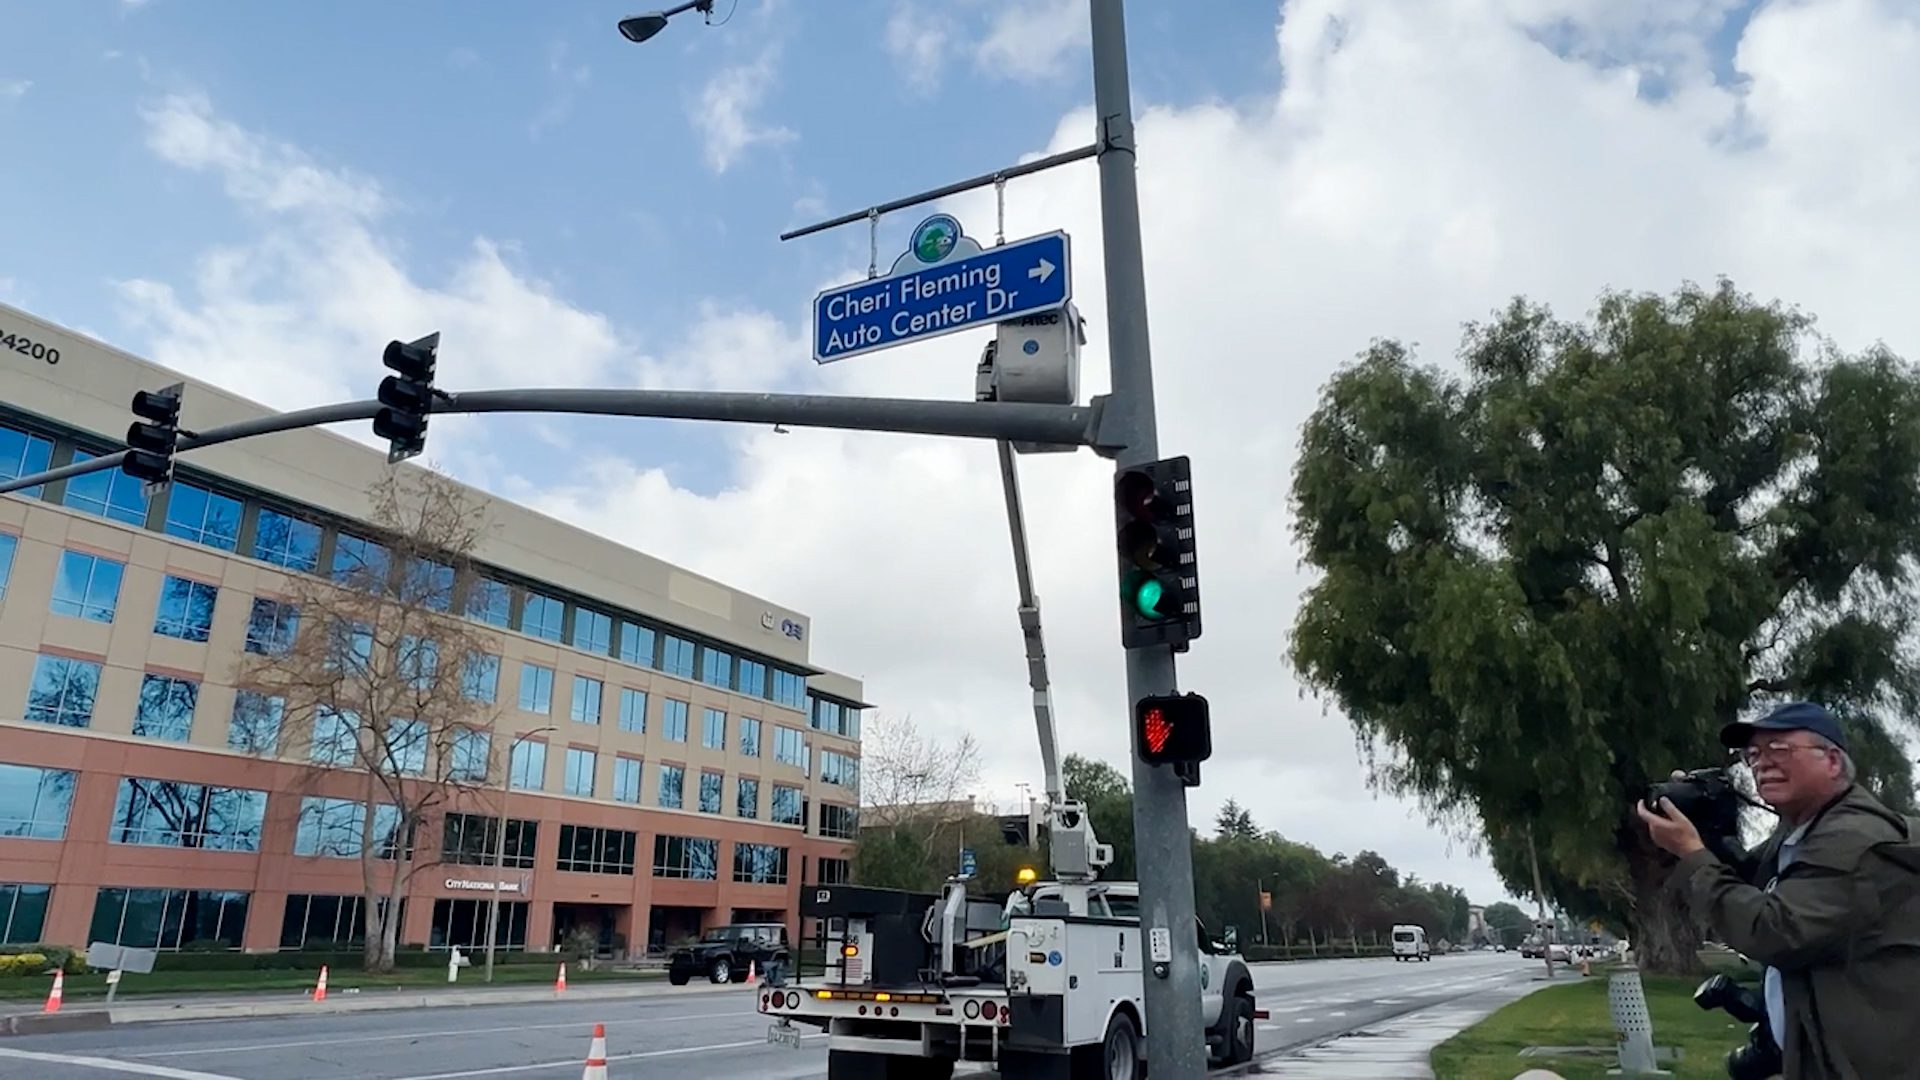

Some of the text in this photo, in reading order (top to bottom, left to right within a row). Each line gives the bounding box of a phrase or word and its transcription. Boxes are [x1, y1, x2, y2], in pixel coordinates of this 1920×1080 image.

[825, 289, 1019, 354] Auto Center Dr
[827, 263, 1001, 321] Cheri Fleming
